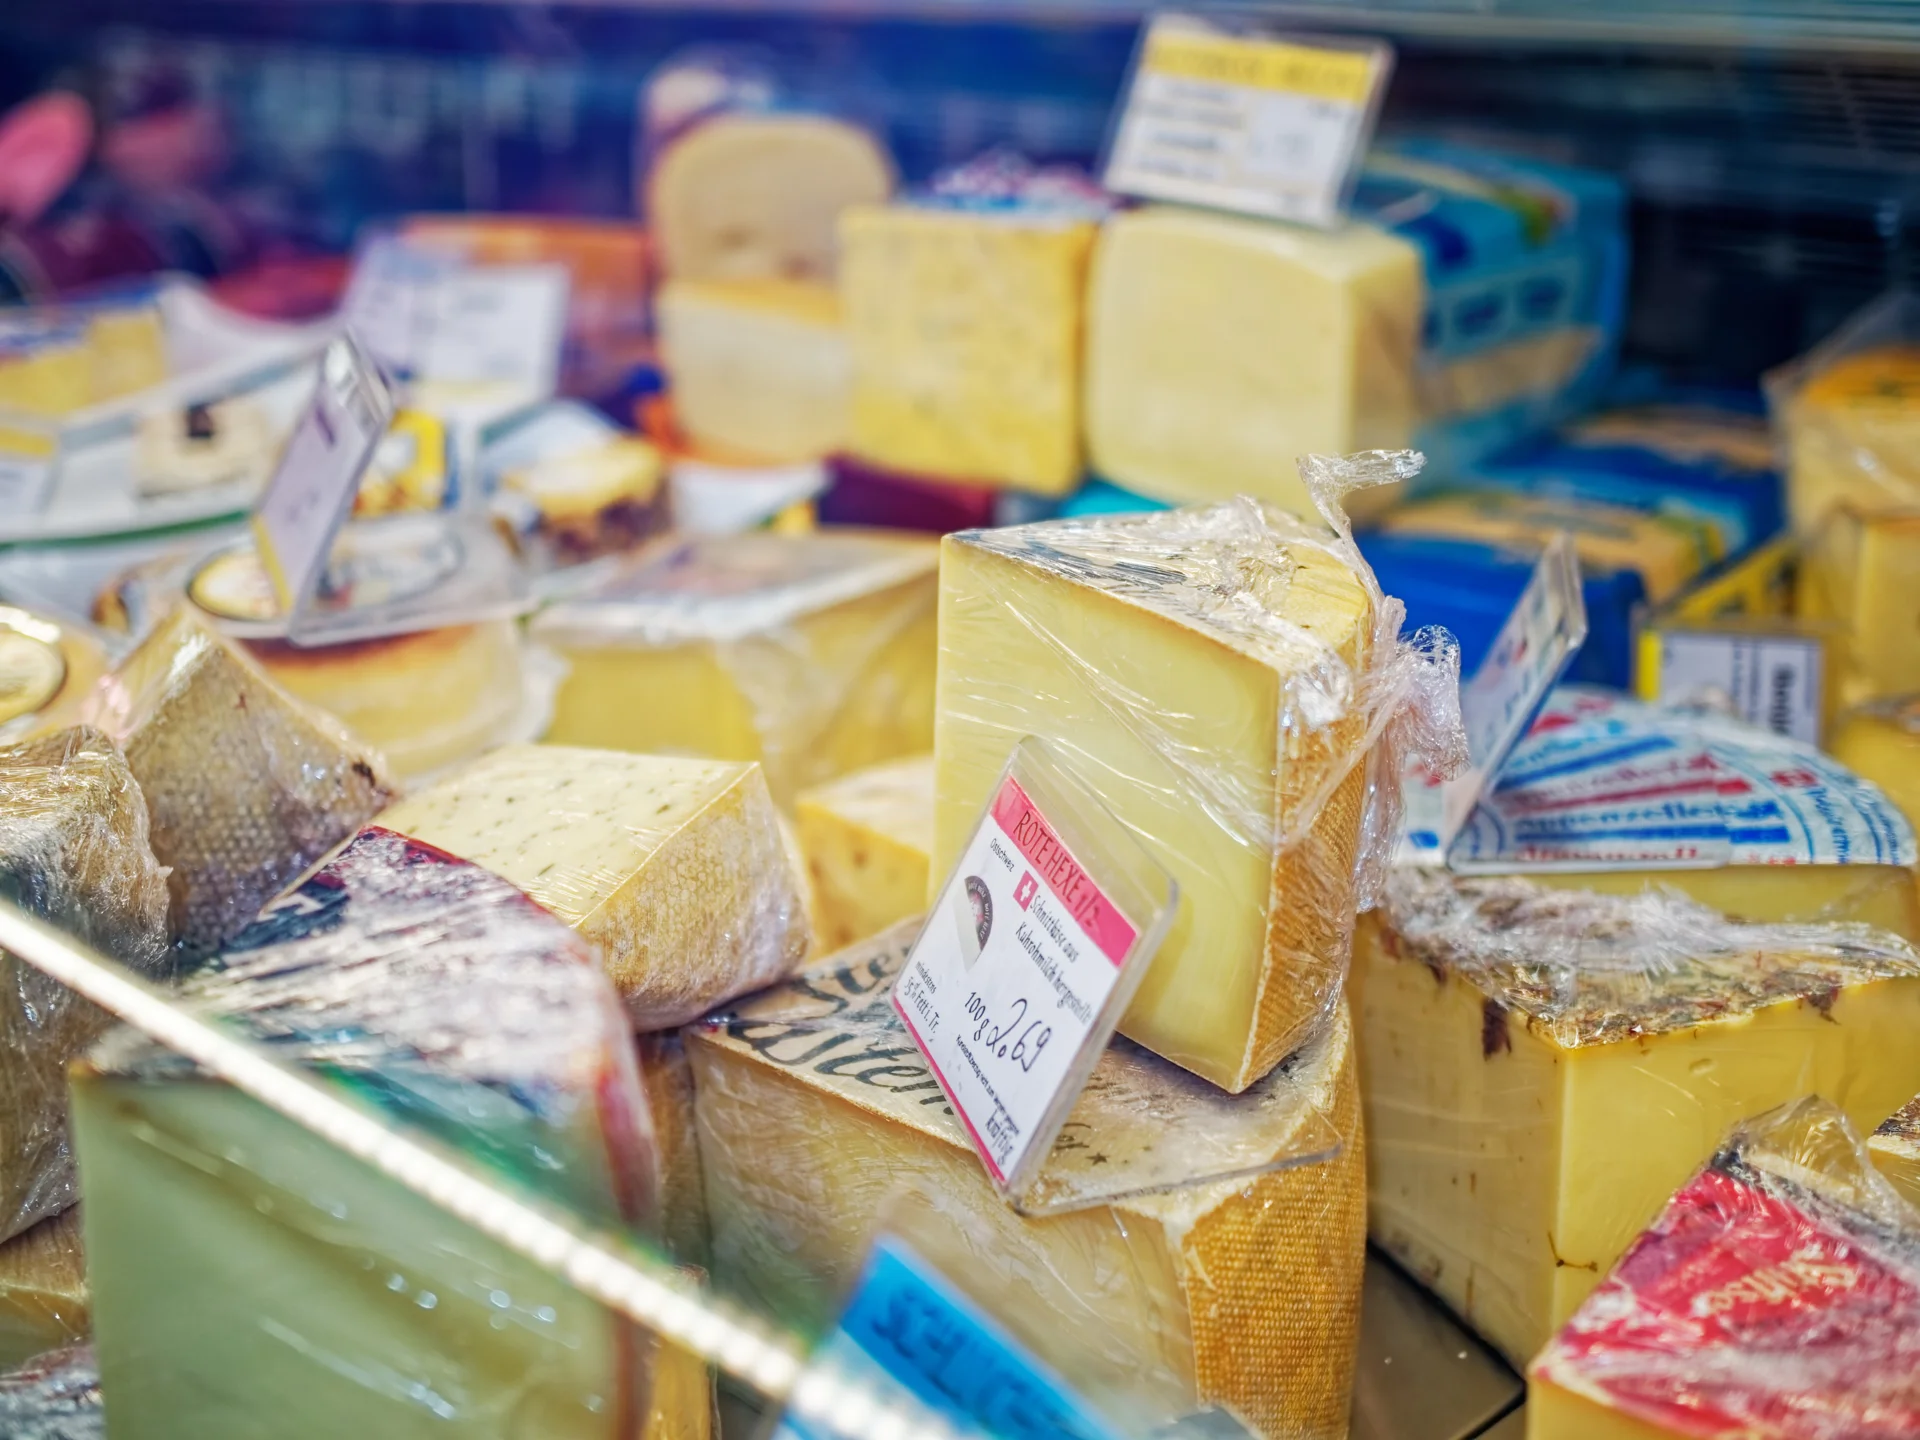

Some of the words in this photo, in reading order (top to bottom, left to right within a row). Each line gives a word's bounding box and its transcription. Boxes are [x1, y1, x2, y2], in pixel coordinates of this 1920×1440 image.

[991, 838, 1014, 873] Ostschweiz
[1013, 809, 1053, 864] ROTE
[1047, 846, 1085, 903] HEXE
[1029, 894, 1066, 947] Schnittkäse
[1063, 943, 1079, 963] aus
[1015, 922, 1058, 981] Kuhrohmilch
[916, 961, 937, 995] mindestens
[913, 990, 930, 1015] Fett
[924, 1006, 934, 1022] i.
[965, 992, 987, 1022] 100
[928, 1012, 940, 1034] Tr.
[974, 1018, 990, 1042] g
[986, 998, 1052, 1073] 2.69
[984, 1112, 1014, 1167] kräftig
